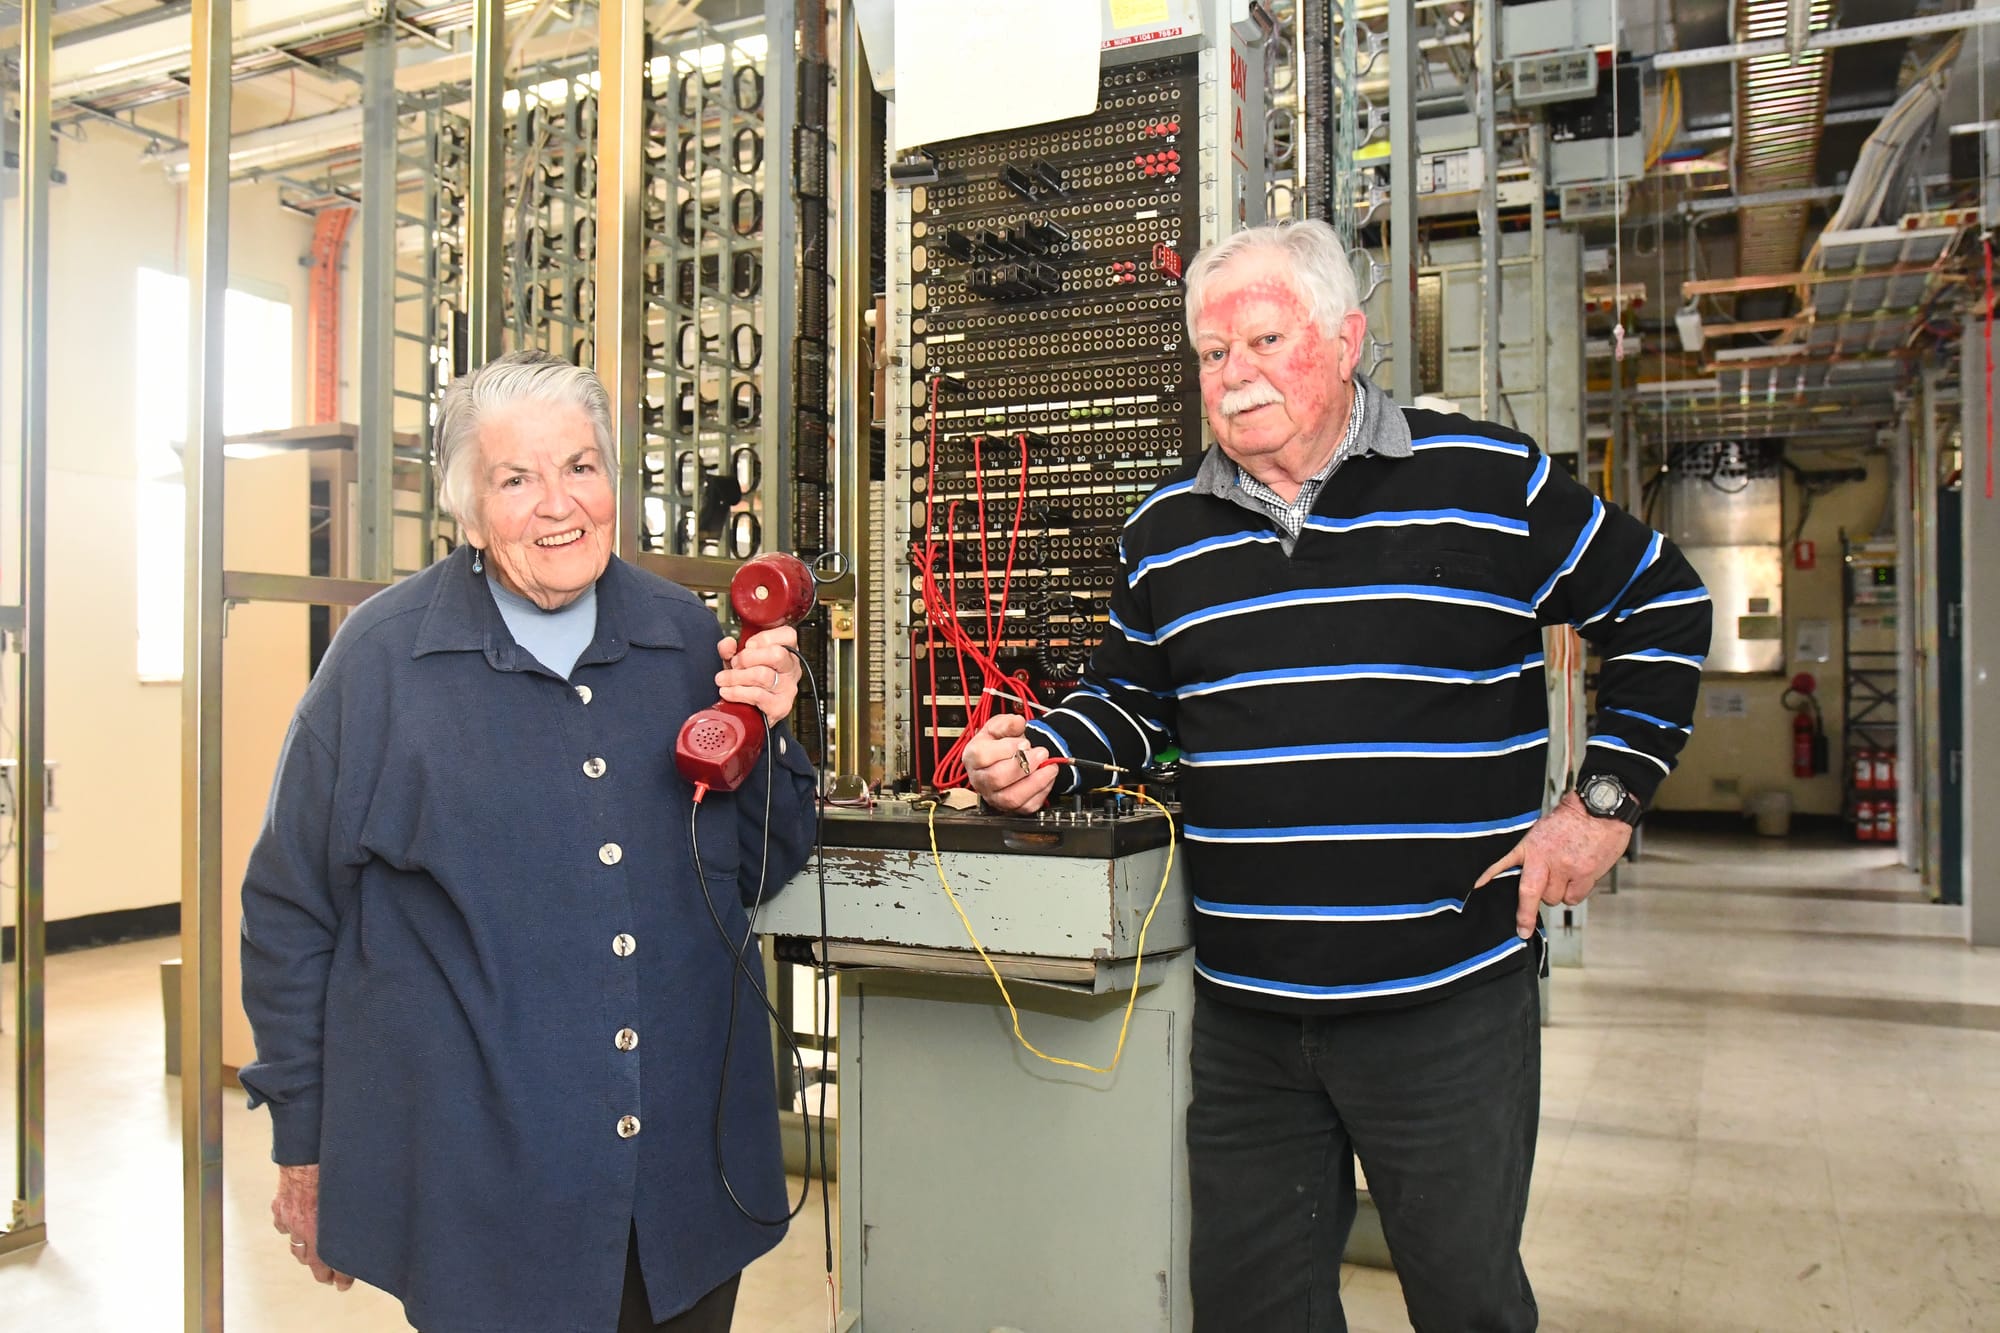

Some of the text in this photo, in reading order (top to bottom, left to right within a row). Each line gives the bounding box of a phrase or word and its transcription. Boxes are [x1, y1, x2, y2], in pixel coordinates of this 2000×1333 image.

[1231, 47, 1247, 103] BAY
[1234, 106, 1243, 150] A
[1166, 135, 1176, 143] 12
[1163, 343, 1177, 351] 60
[1164, 384, 1175, 392] 72
[1166, 449, 1179, 457] 84
